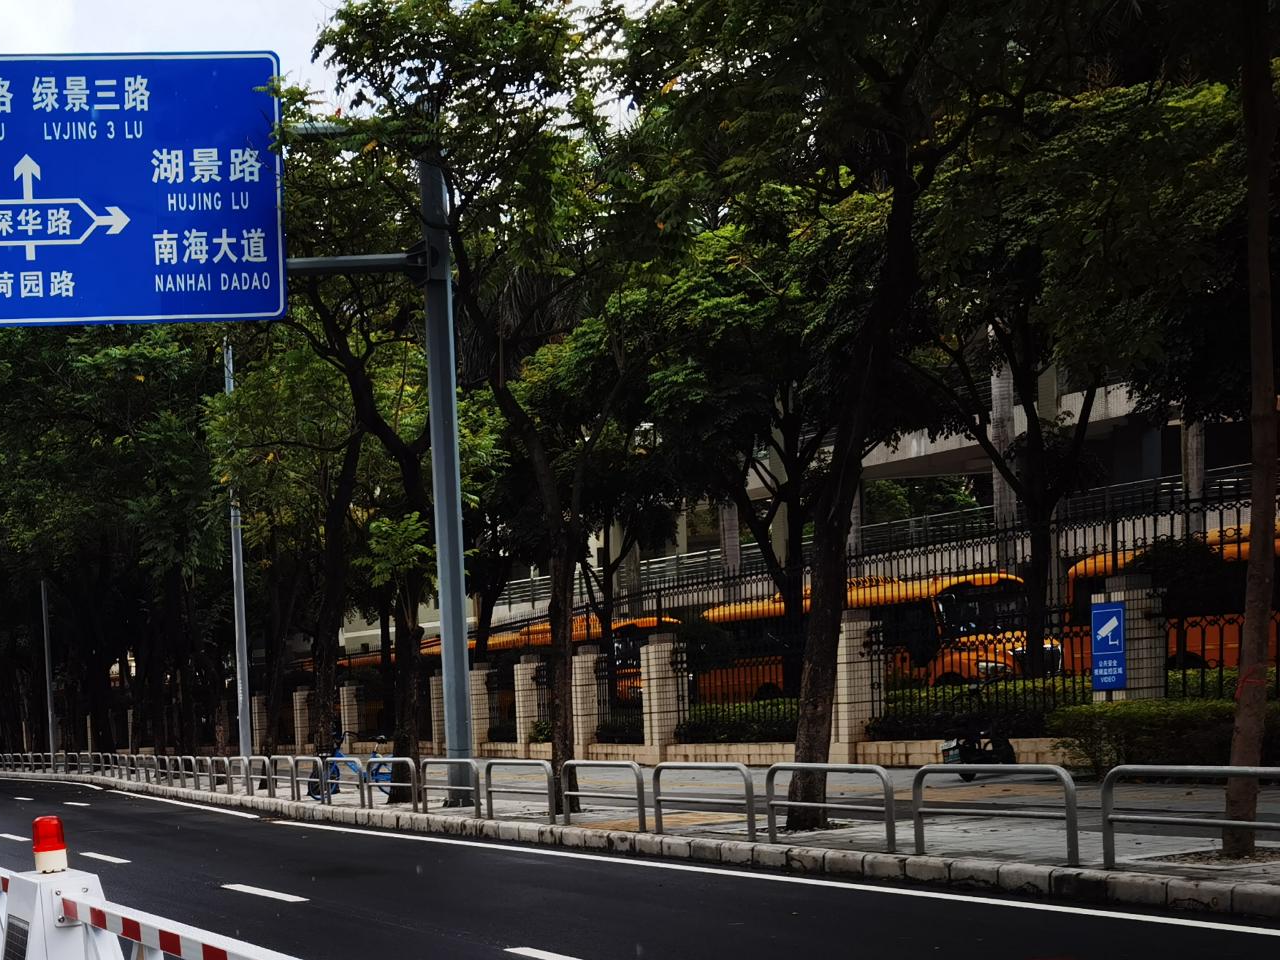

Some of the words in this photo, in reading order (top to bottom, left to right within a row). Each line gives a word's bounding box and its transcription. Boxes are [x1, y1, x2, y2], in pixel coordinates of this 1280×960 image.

[32, 75, 150, 113] 绿景三路
[43, 121, 97, 140] LVJING
[107, 121, 115, 139] 3
[124, 120, 143, 139] LU
[150, 147, 262, 184] 湖景路
[167, 192, 222, 211] HUJING
[231, 192, 249, 210] LU
[152, 228, 267, 266] 南海大道
[155, 273, 211, 292] NANHAI
[221, 272, 270, 291] DADAO
